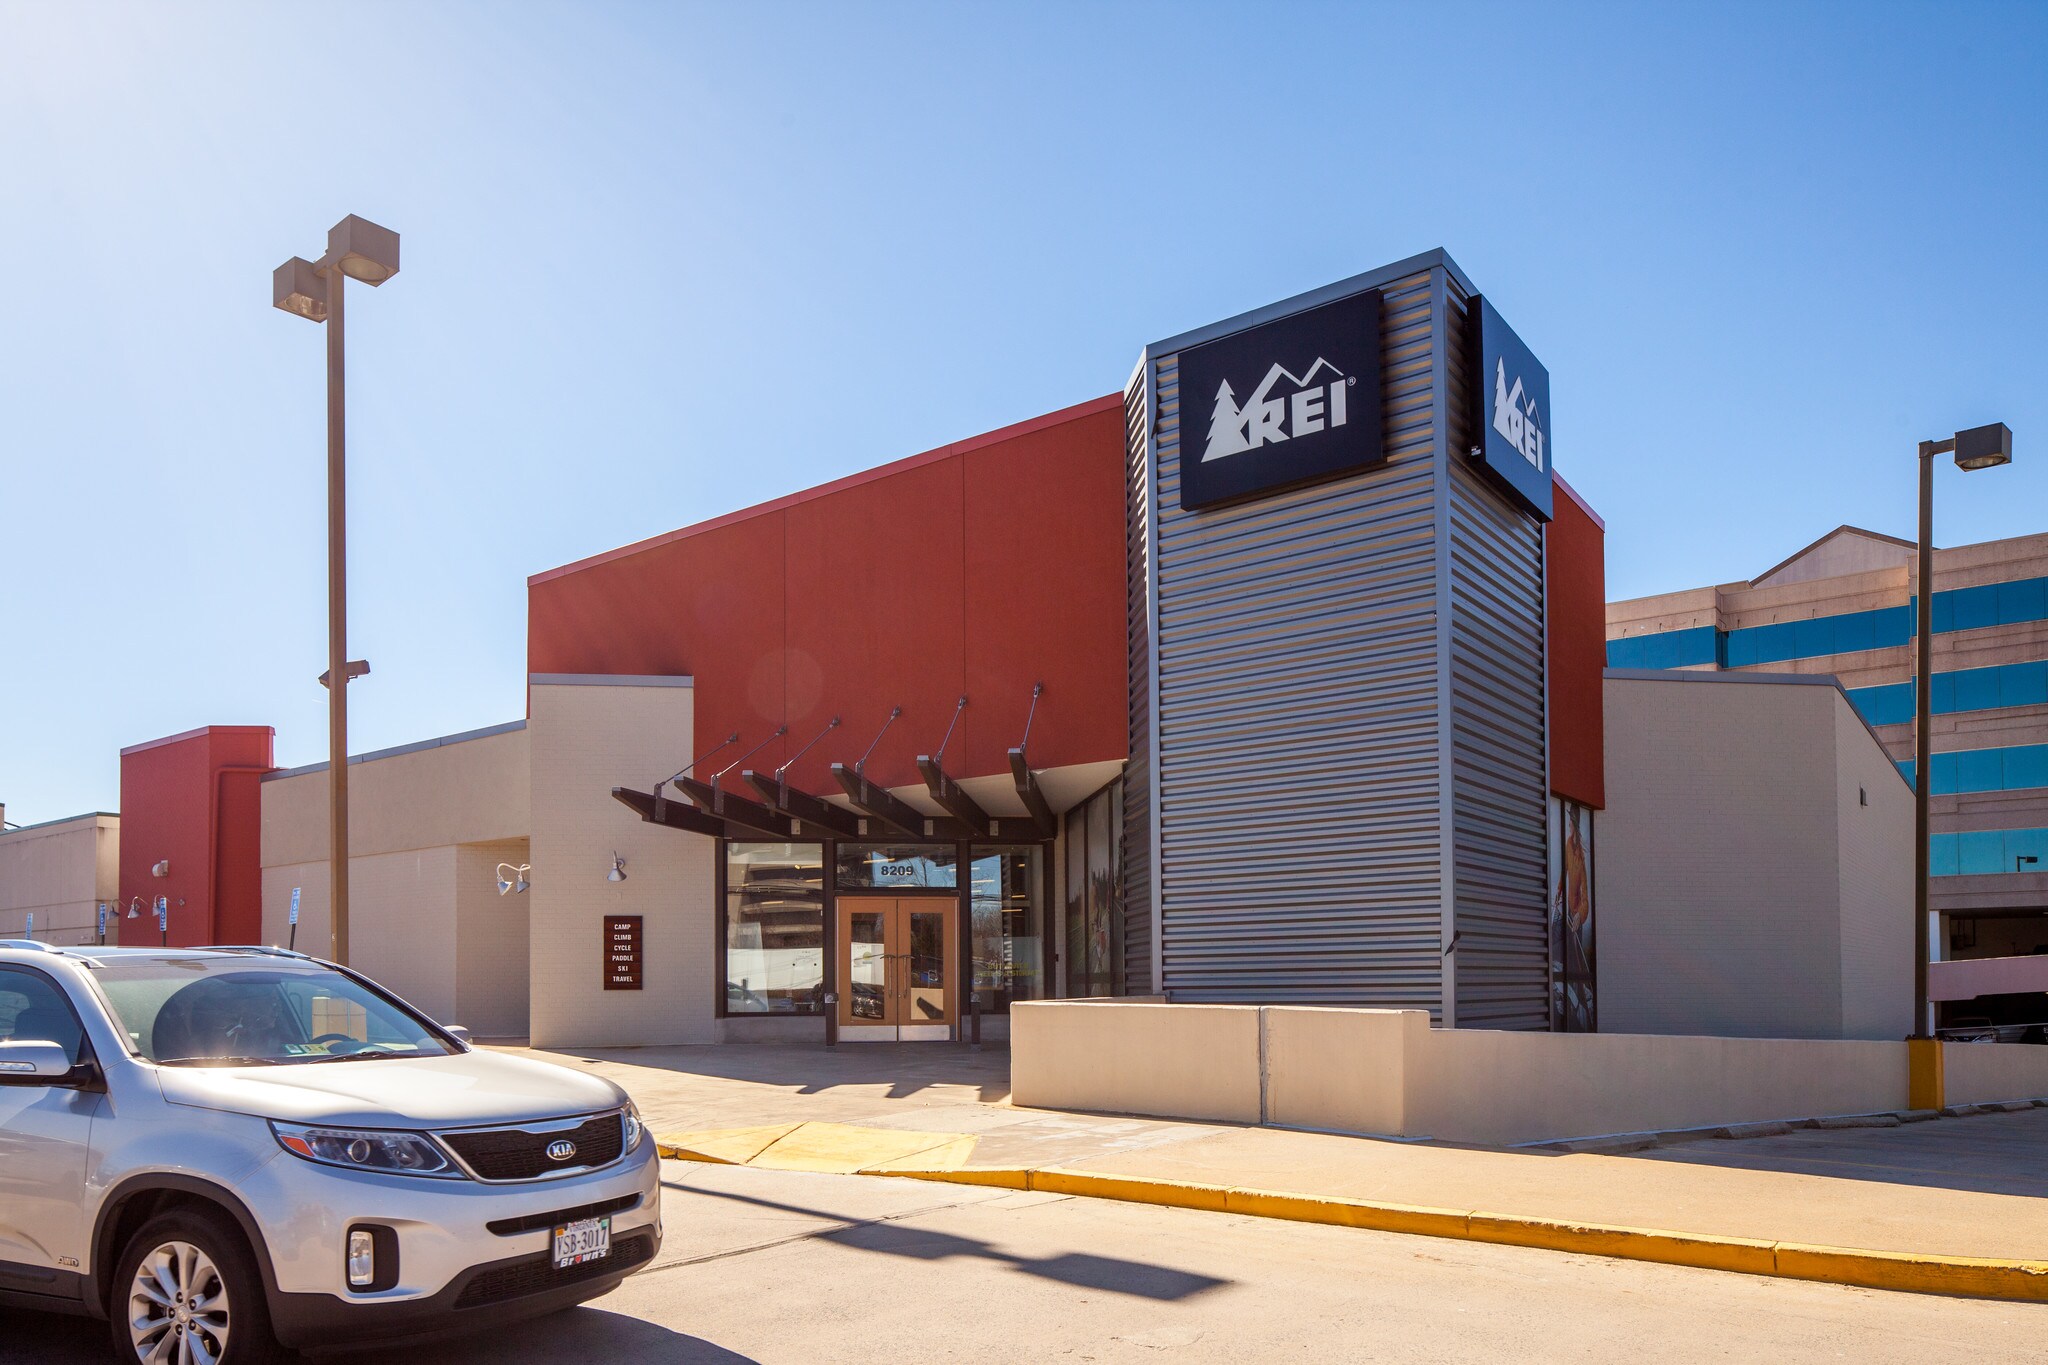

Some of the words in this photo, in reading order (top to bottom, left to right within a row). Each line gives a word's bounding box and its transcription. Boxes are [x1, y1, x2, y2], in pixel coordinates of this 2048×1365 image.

[1249, 379, 1348, 447] REI
[881, 865, 914, 876] 8209
[552, 1143, 574, 1157] KIA
[556, 1229, 607, 1256] VSB-3017
[58, 1255, 80, 1268] AWD
